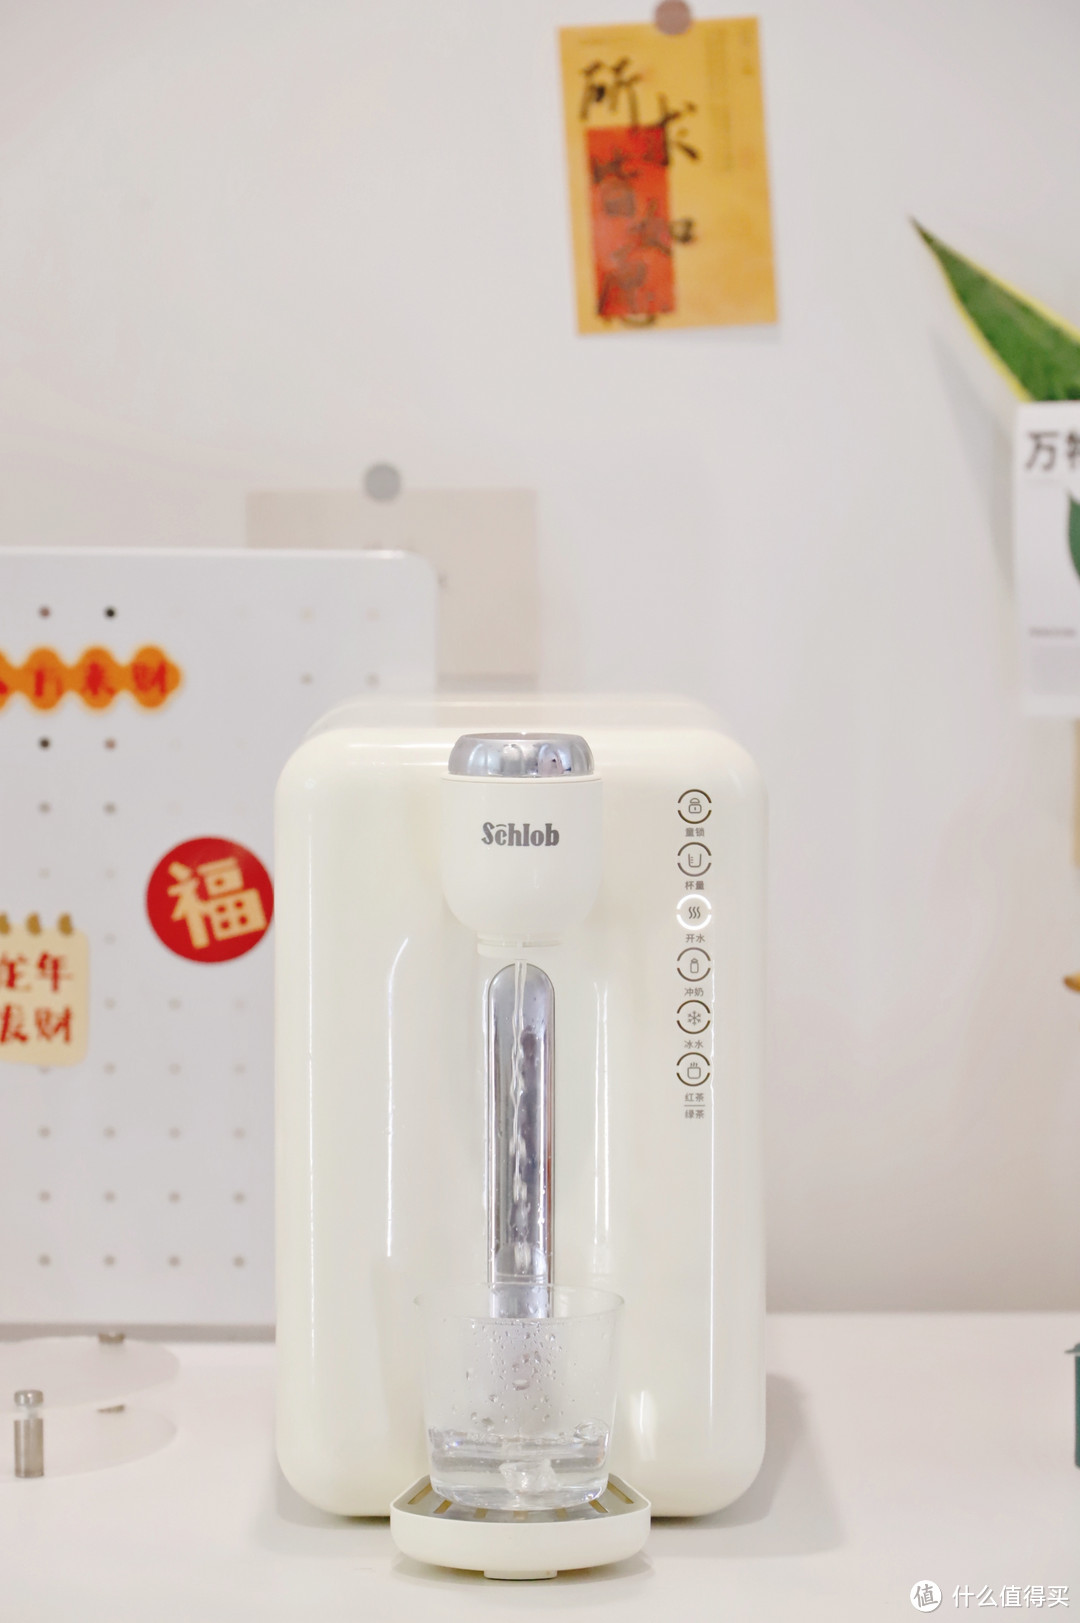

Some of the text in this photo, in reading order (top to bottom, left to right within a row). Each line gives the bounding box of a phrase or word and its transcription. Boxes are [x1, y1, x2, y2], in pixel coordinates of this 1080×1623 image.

[481, 822, 560, 847] Schlob
[685, 827, 705, 838] 童锁
[685, 880, 705, 891] 杯量
[167, 856, 268, 950] 福
[685, 933, 706, 944] 开水
[684, 987, 704, 997] 冲奶
[684, 1039, 704, 1050] 冰水
[684, 1092, 704, 1103] 红茶
[684, 1109, 704, 1119] 绿茶
